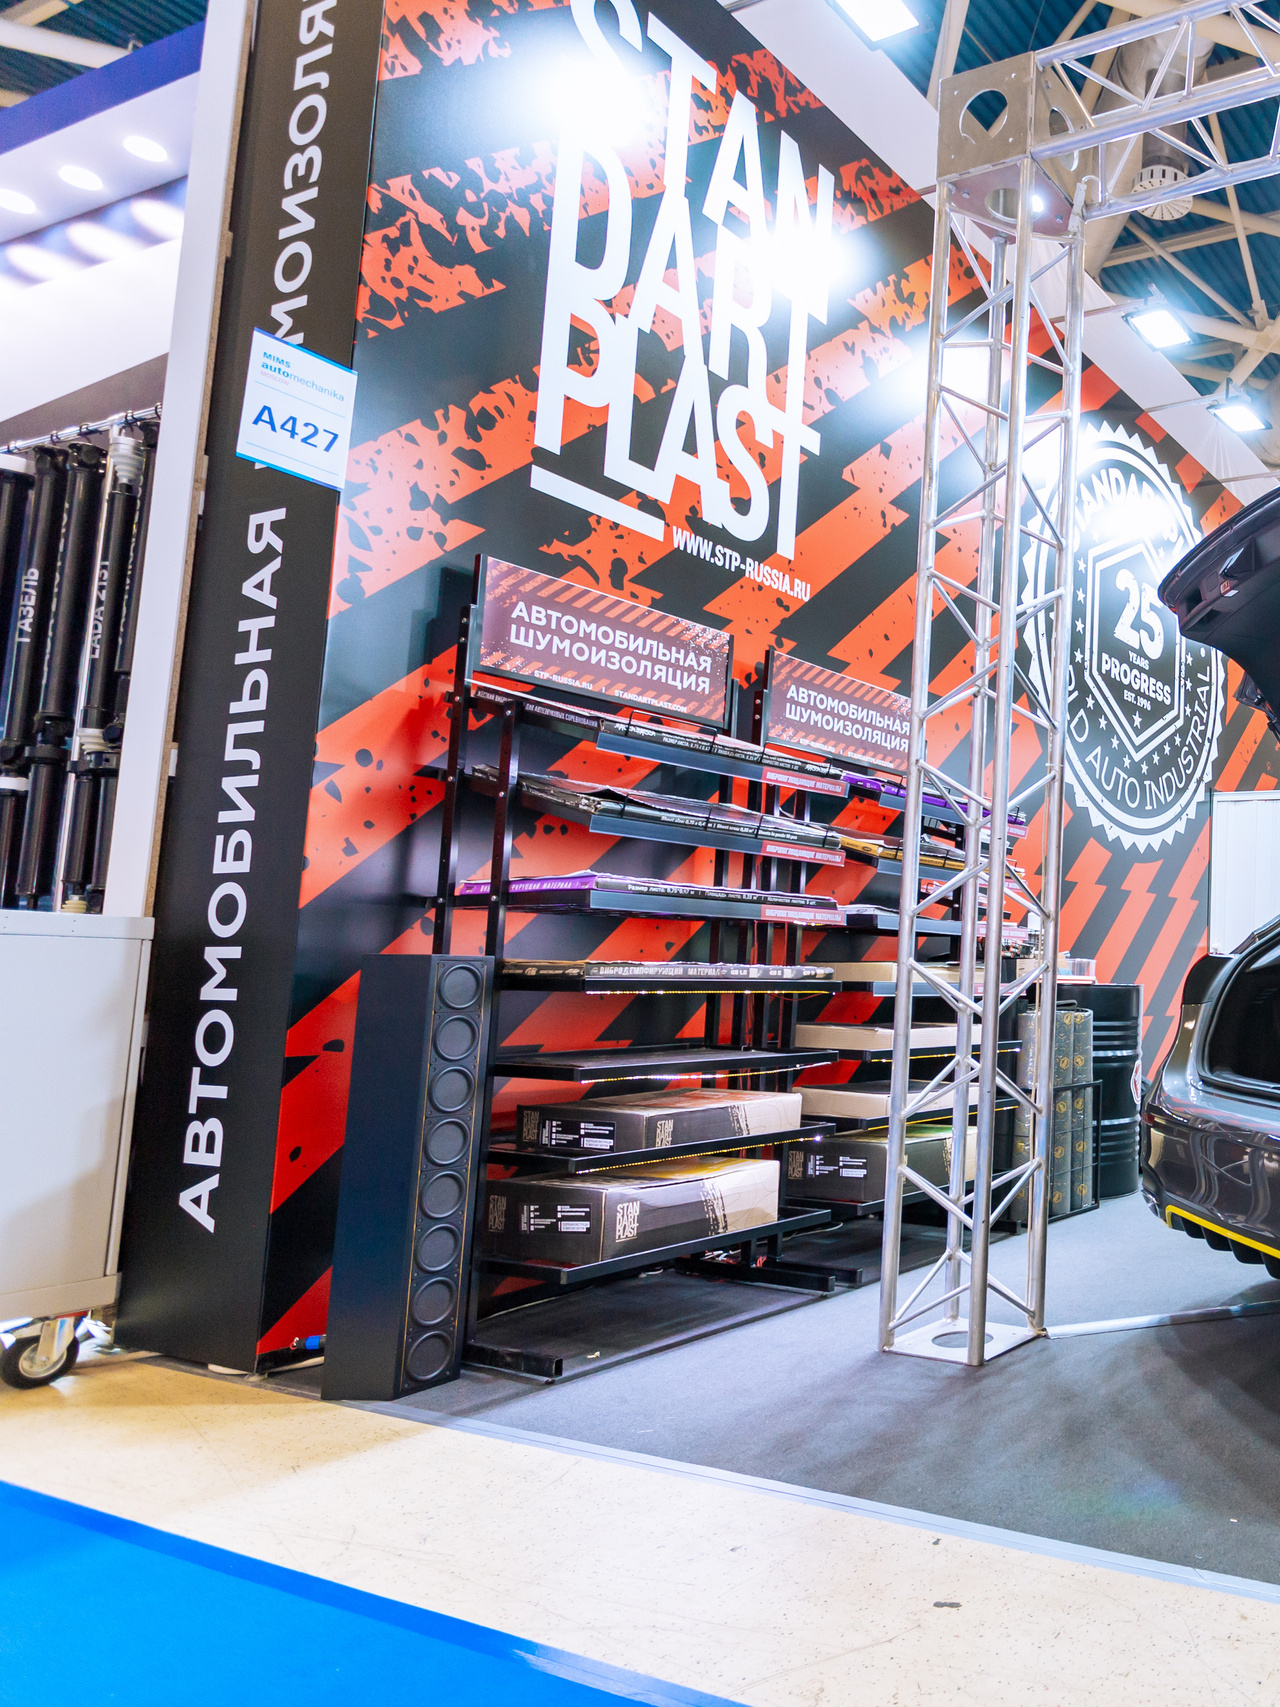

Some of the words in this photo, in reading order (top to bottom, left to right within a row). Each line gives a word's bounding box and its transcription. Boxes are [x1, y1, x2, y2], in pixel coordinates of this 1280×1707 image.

[260, 370, 289, 386] MOSCOW
[261, 361, 344, 402] automechanika
[263, 351, 291, 368] MIMS
[252, 405, 339, 452] A427
[534, 303, 821, 560] PLAST
[672, 525, 811, 602] WWW.STP-RUSSIA.RU
[1113, 568, 1164, 660] 25
[510, 624, 711, 694] ШУМОИЗОЛЯЦИЯ
[511, 601, 712, 673] АВТОМОБИЛЬНАЯ
[1101, 652, 1172, 706] PROGRESS
[1128, 650, 1150, 671] YEARS
[534, 670, 593, 690] STP-RUSSIA.RU
[614, 689, 688, 713] STANDARTPLAST.COM
[787, 684, 911, 736] АВТОМОБИЛЬНАЯ
[1123, 689, 1136, 705] EST.
[1136, 695, 1151, 711] 1996
[785, 702, 909, 753] ШУМОИЗОЛЯЦИЯ
[1085, 746, 1140, 808] AUTO
[1144, 666, 1210, 810] INDUSTRIAL
[178, 507, 287, 1233] АВТОМОБИЛЬНАЯ
[599, 966, 683, 976] ВИБРОДЕМПФИРУЮЩИЙ
[687, 967, 721, 976] МАТЕРИАЛ
[656, 1119, 674, 1131] STAN
[616, 1201, 640, 1216] STAN
[616, 1213, 639, 1229] DART
[615, 1224, 639, 1241] PLAST
